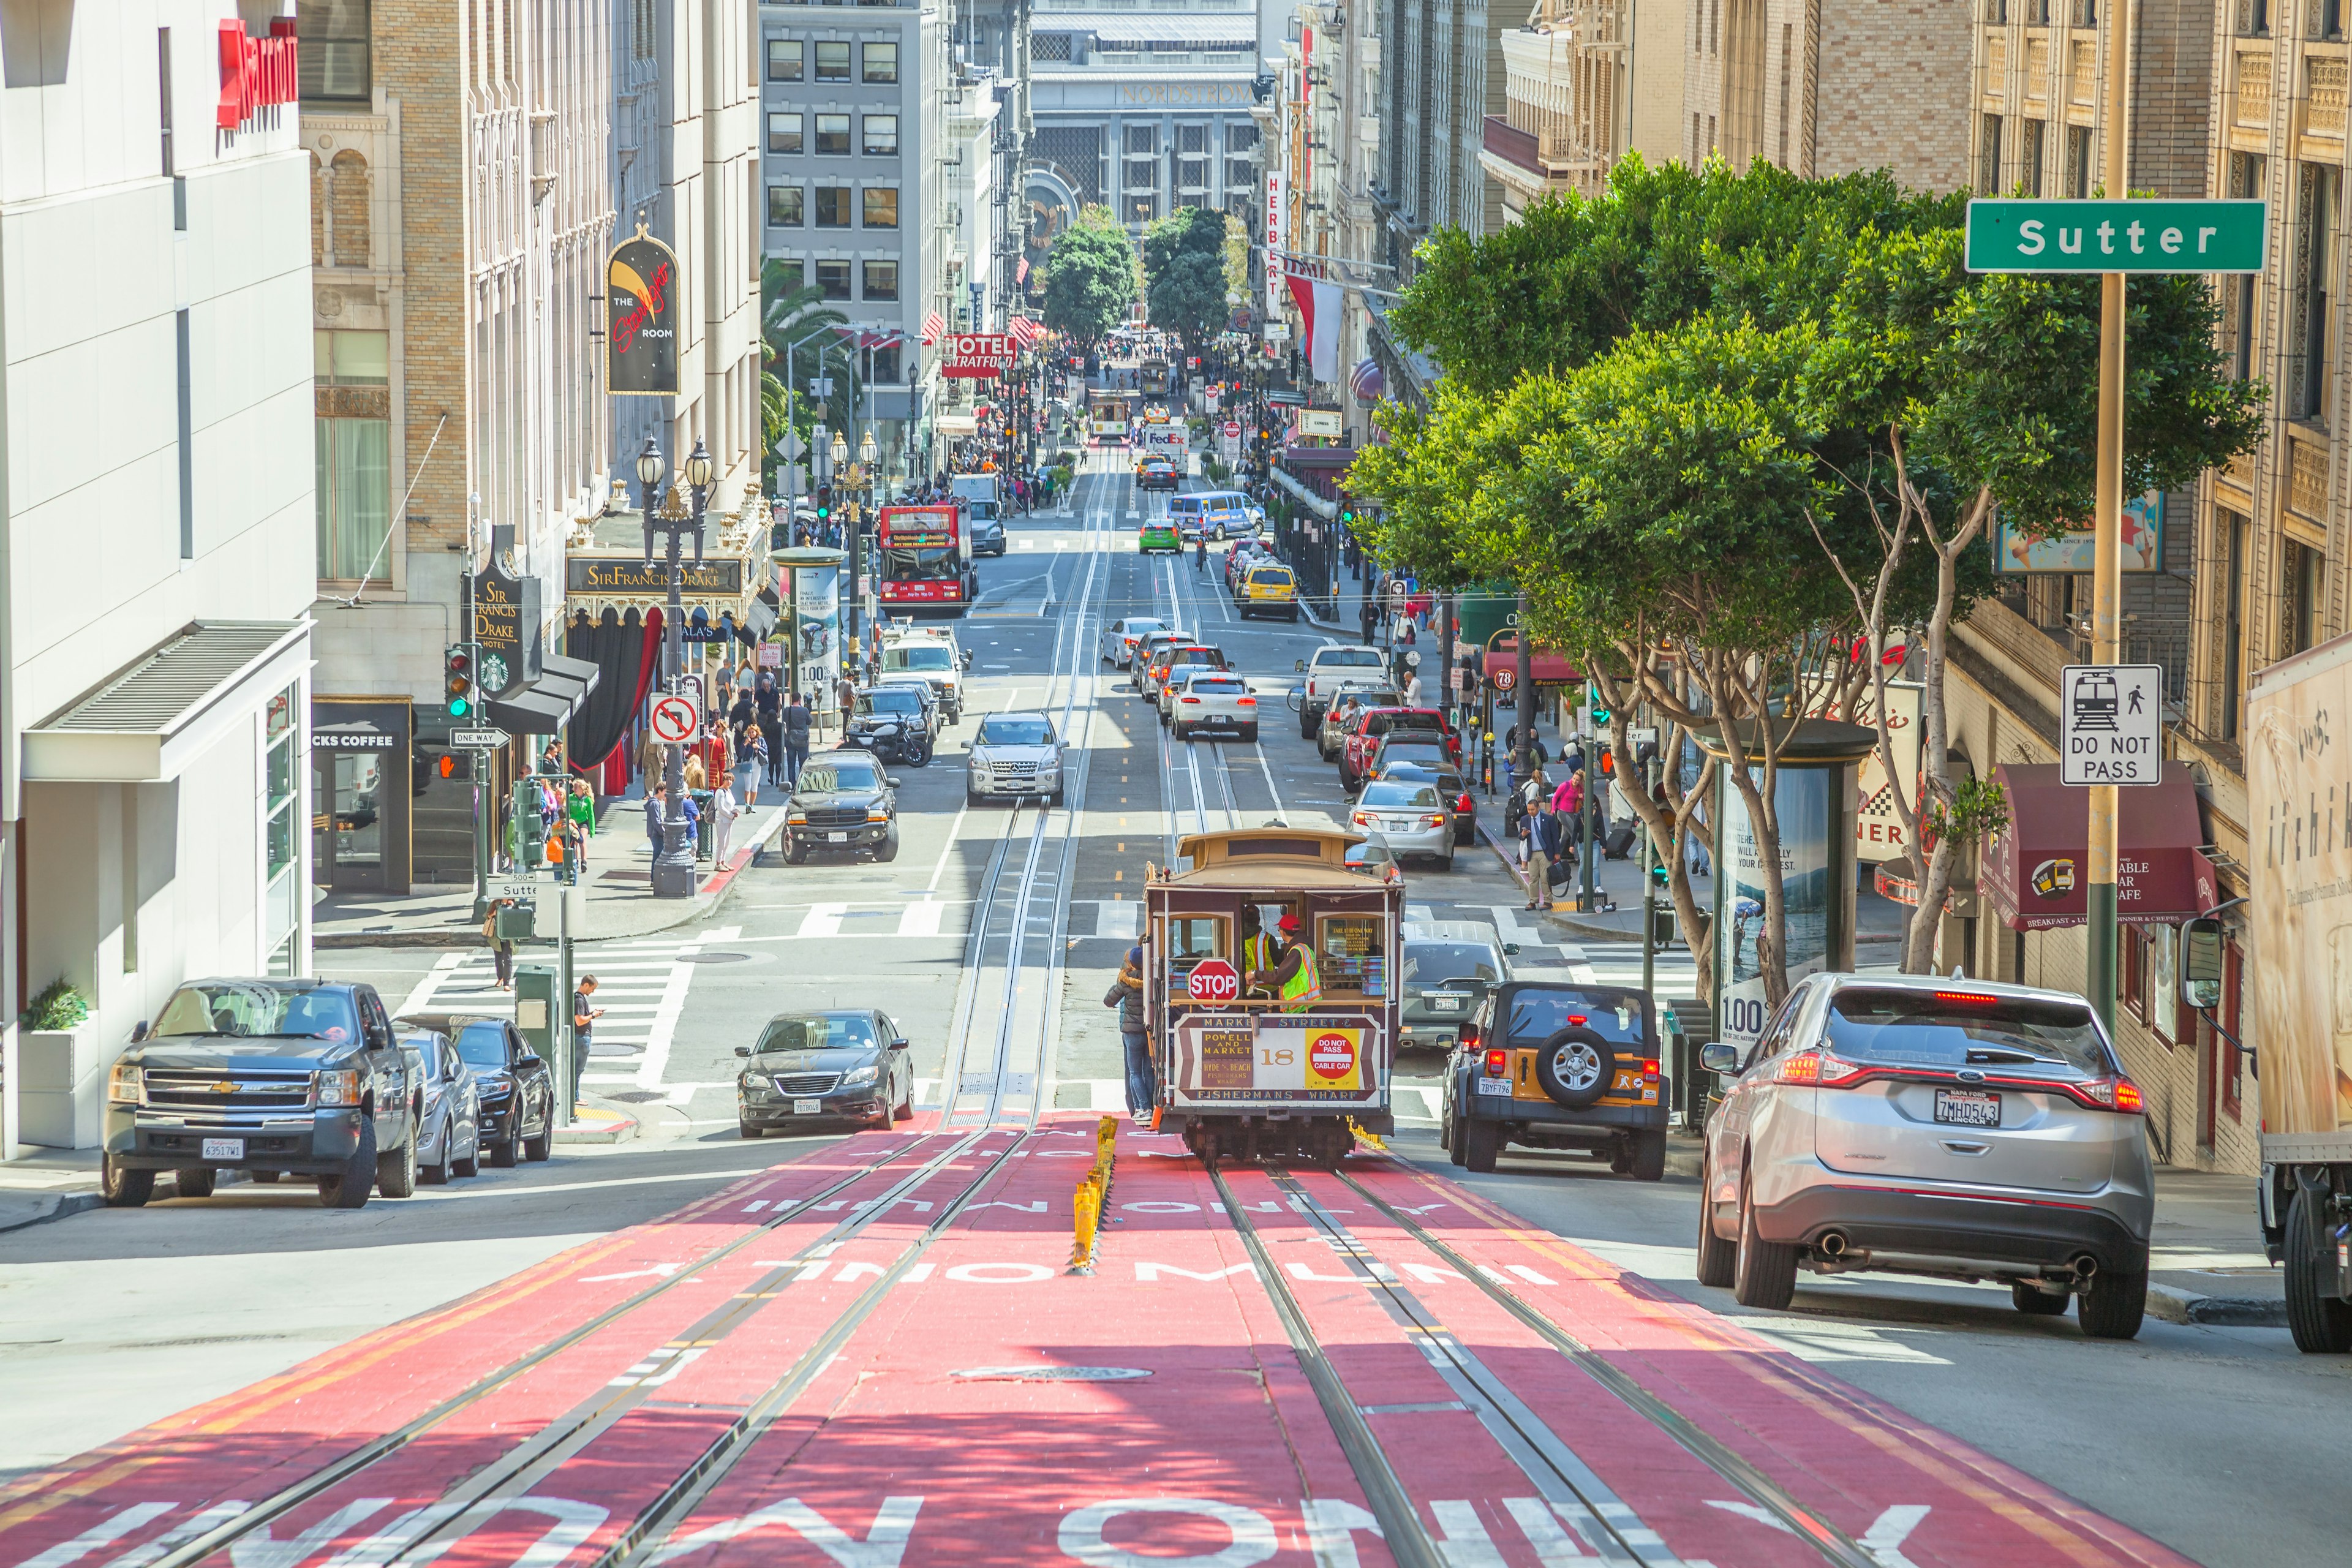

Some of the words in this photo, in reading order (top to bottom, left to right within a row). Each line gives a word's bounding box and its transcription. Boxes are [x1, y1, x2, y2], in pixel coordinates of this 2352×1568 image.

[1123, 85, 1253, 104] NORDSTROM
[1269, 178, 1278, 295] HERBERT
[2016, 219, 2217, 255] Sutter
[614, 298, 633, 306] THE
[614, 262, 668, 353] Starlight
[642, 329, 673, 337] ROOM
[944, 337, 1014, 355] HOTEL
[944, 356, 1012, 368] STRATFOD
[1150, 432, 1184, 445] FedEx
[483, 640, 505, 649] HOTEL
[1498, 673, 1511, 684] 78
[341, 736, 393, 747] COFFEE
[2071, 737, 2098, 754] DO
[2111, 737, 2150, 754] NOT
[2084, 761, 2138, 778] PASS
[1738, 846, 1752, 856] WILL
[1738, 858, 1755, 869] YOUR
[2118, 862, 2149, 873] ABLE
[2118, 876, 2134, 886] AR
[2116, 889, 2141, 900] AFE
[2027, 918, 2069, 927] BREAKFAST
[1191, 974, 1236, 994] STOP
[1204, 1018, 1264, 1028] MARKE
[1279, 1018, 1338, 1028] STREET
[1261, 1049, 1294, 1065] 18
[1196, 1090, 1293, 1100] FISHERMANS
[1308, 1090, 1358, 1100] WHARF
[1481, 1084, 1510, 1095] 7BYF796
[1940, 1101, 1996, 1120] 7MHD543
[205, 1146, 240, 1156] 63517W1
